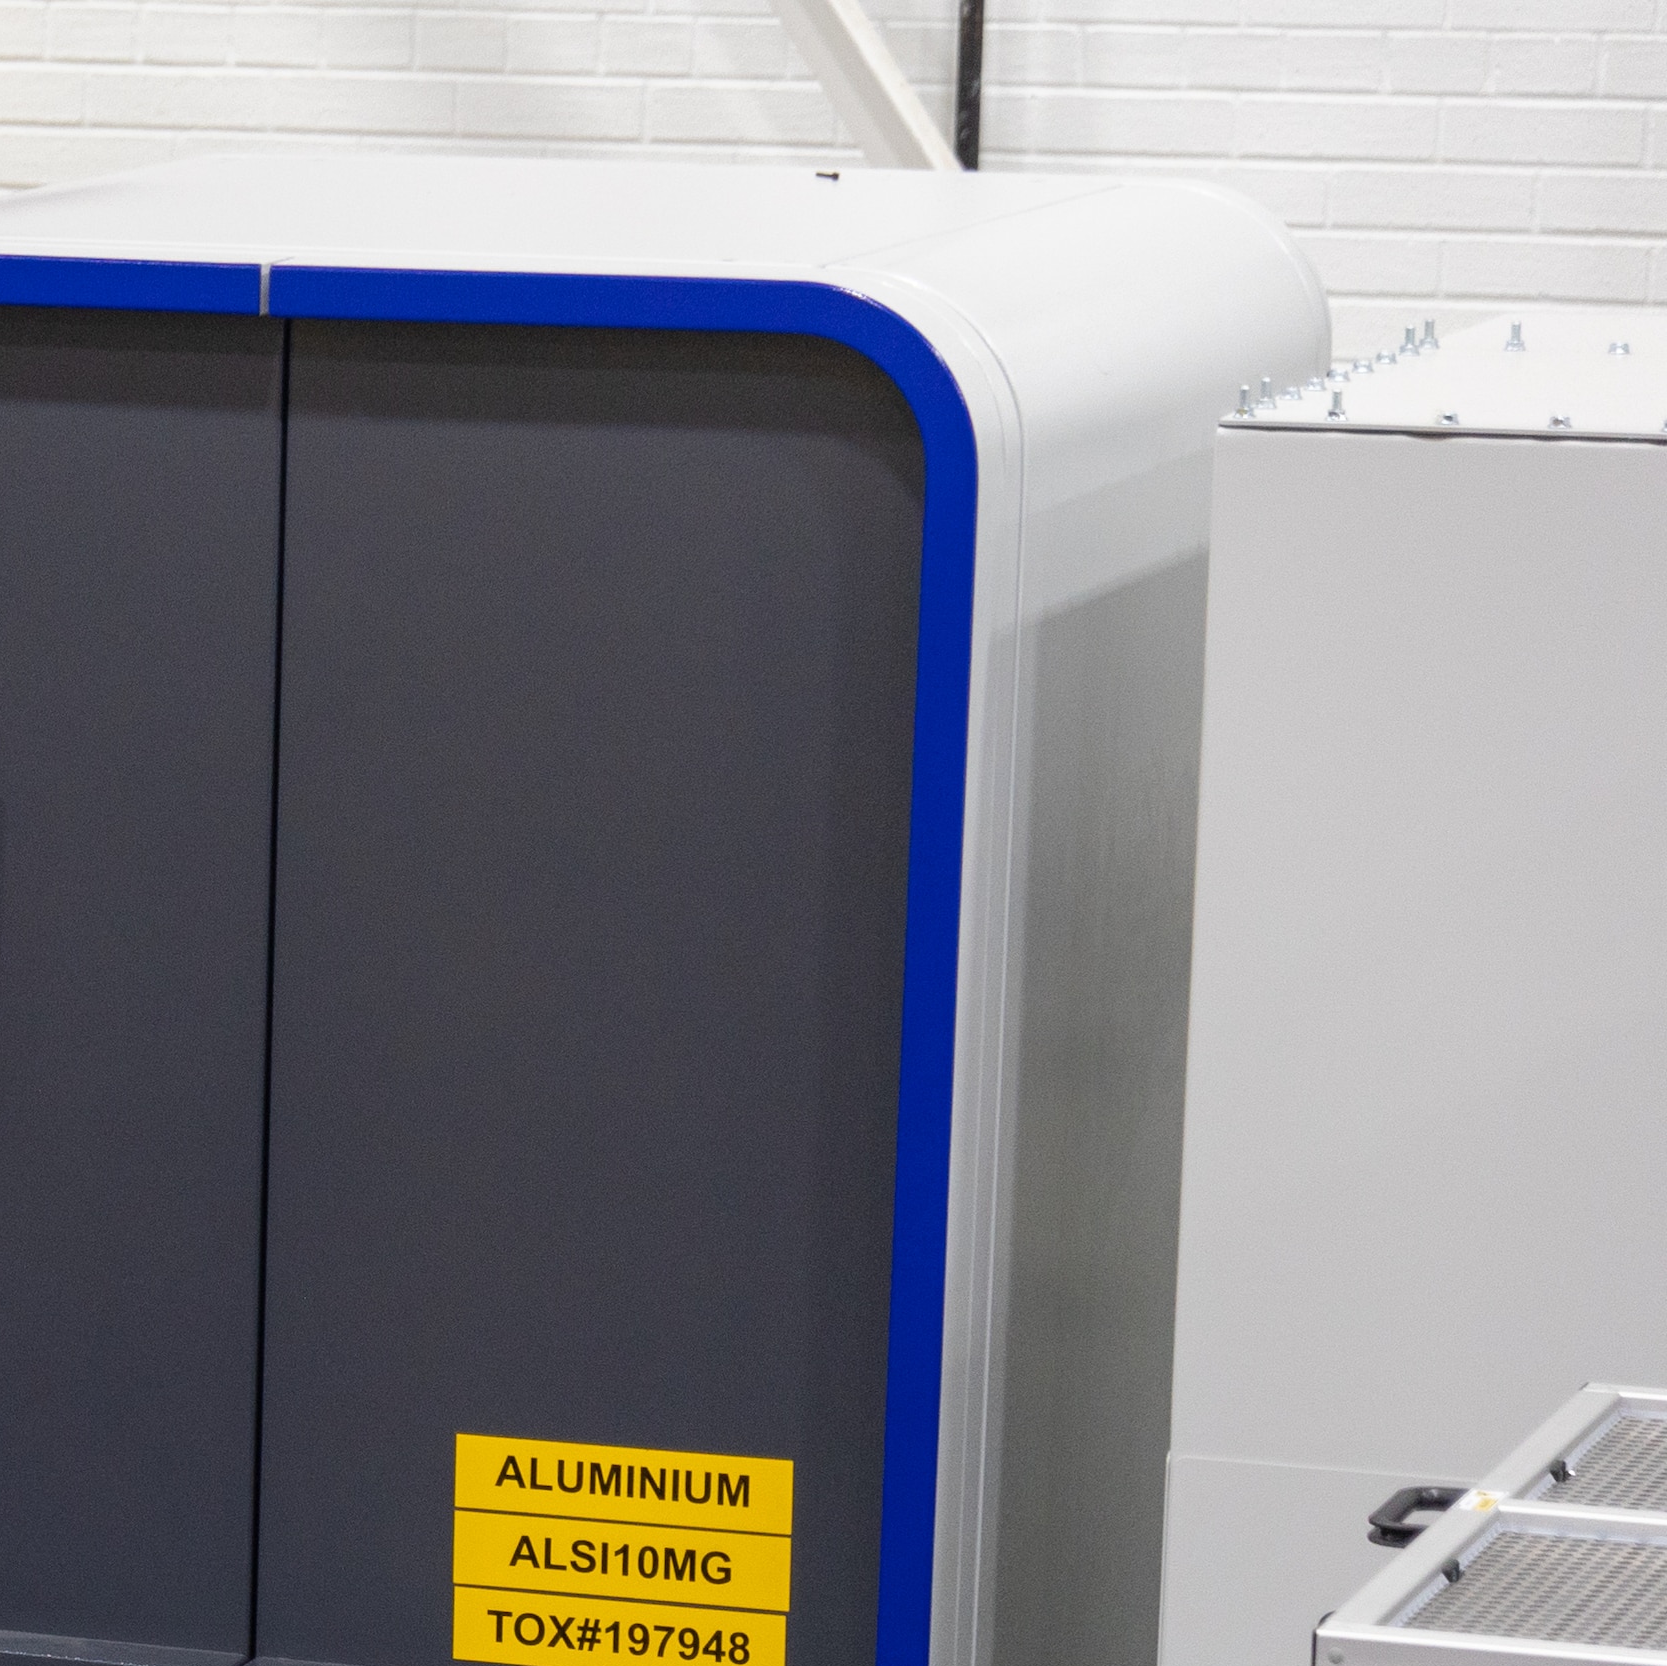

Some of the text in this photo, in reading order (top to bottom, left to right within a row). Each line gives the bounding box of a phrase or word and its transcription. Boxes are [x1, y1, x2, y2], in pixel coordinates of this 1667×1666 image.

[495, 1455, 751, 1508] ALUMINIUM
[509, 1535, 732, 1585] ALSI10MG
[487, 1610, 751, 1665] TOX#197948
